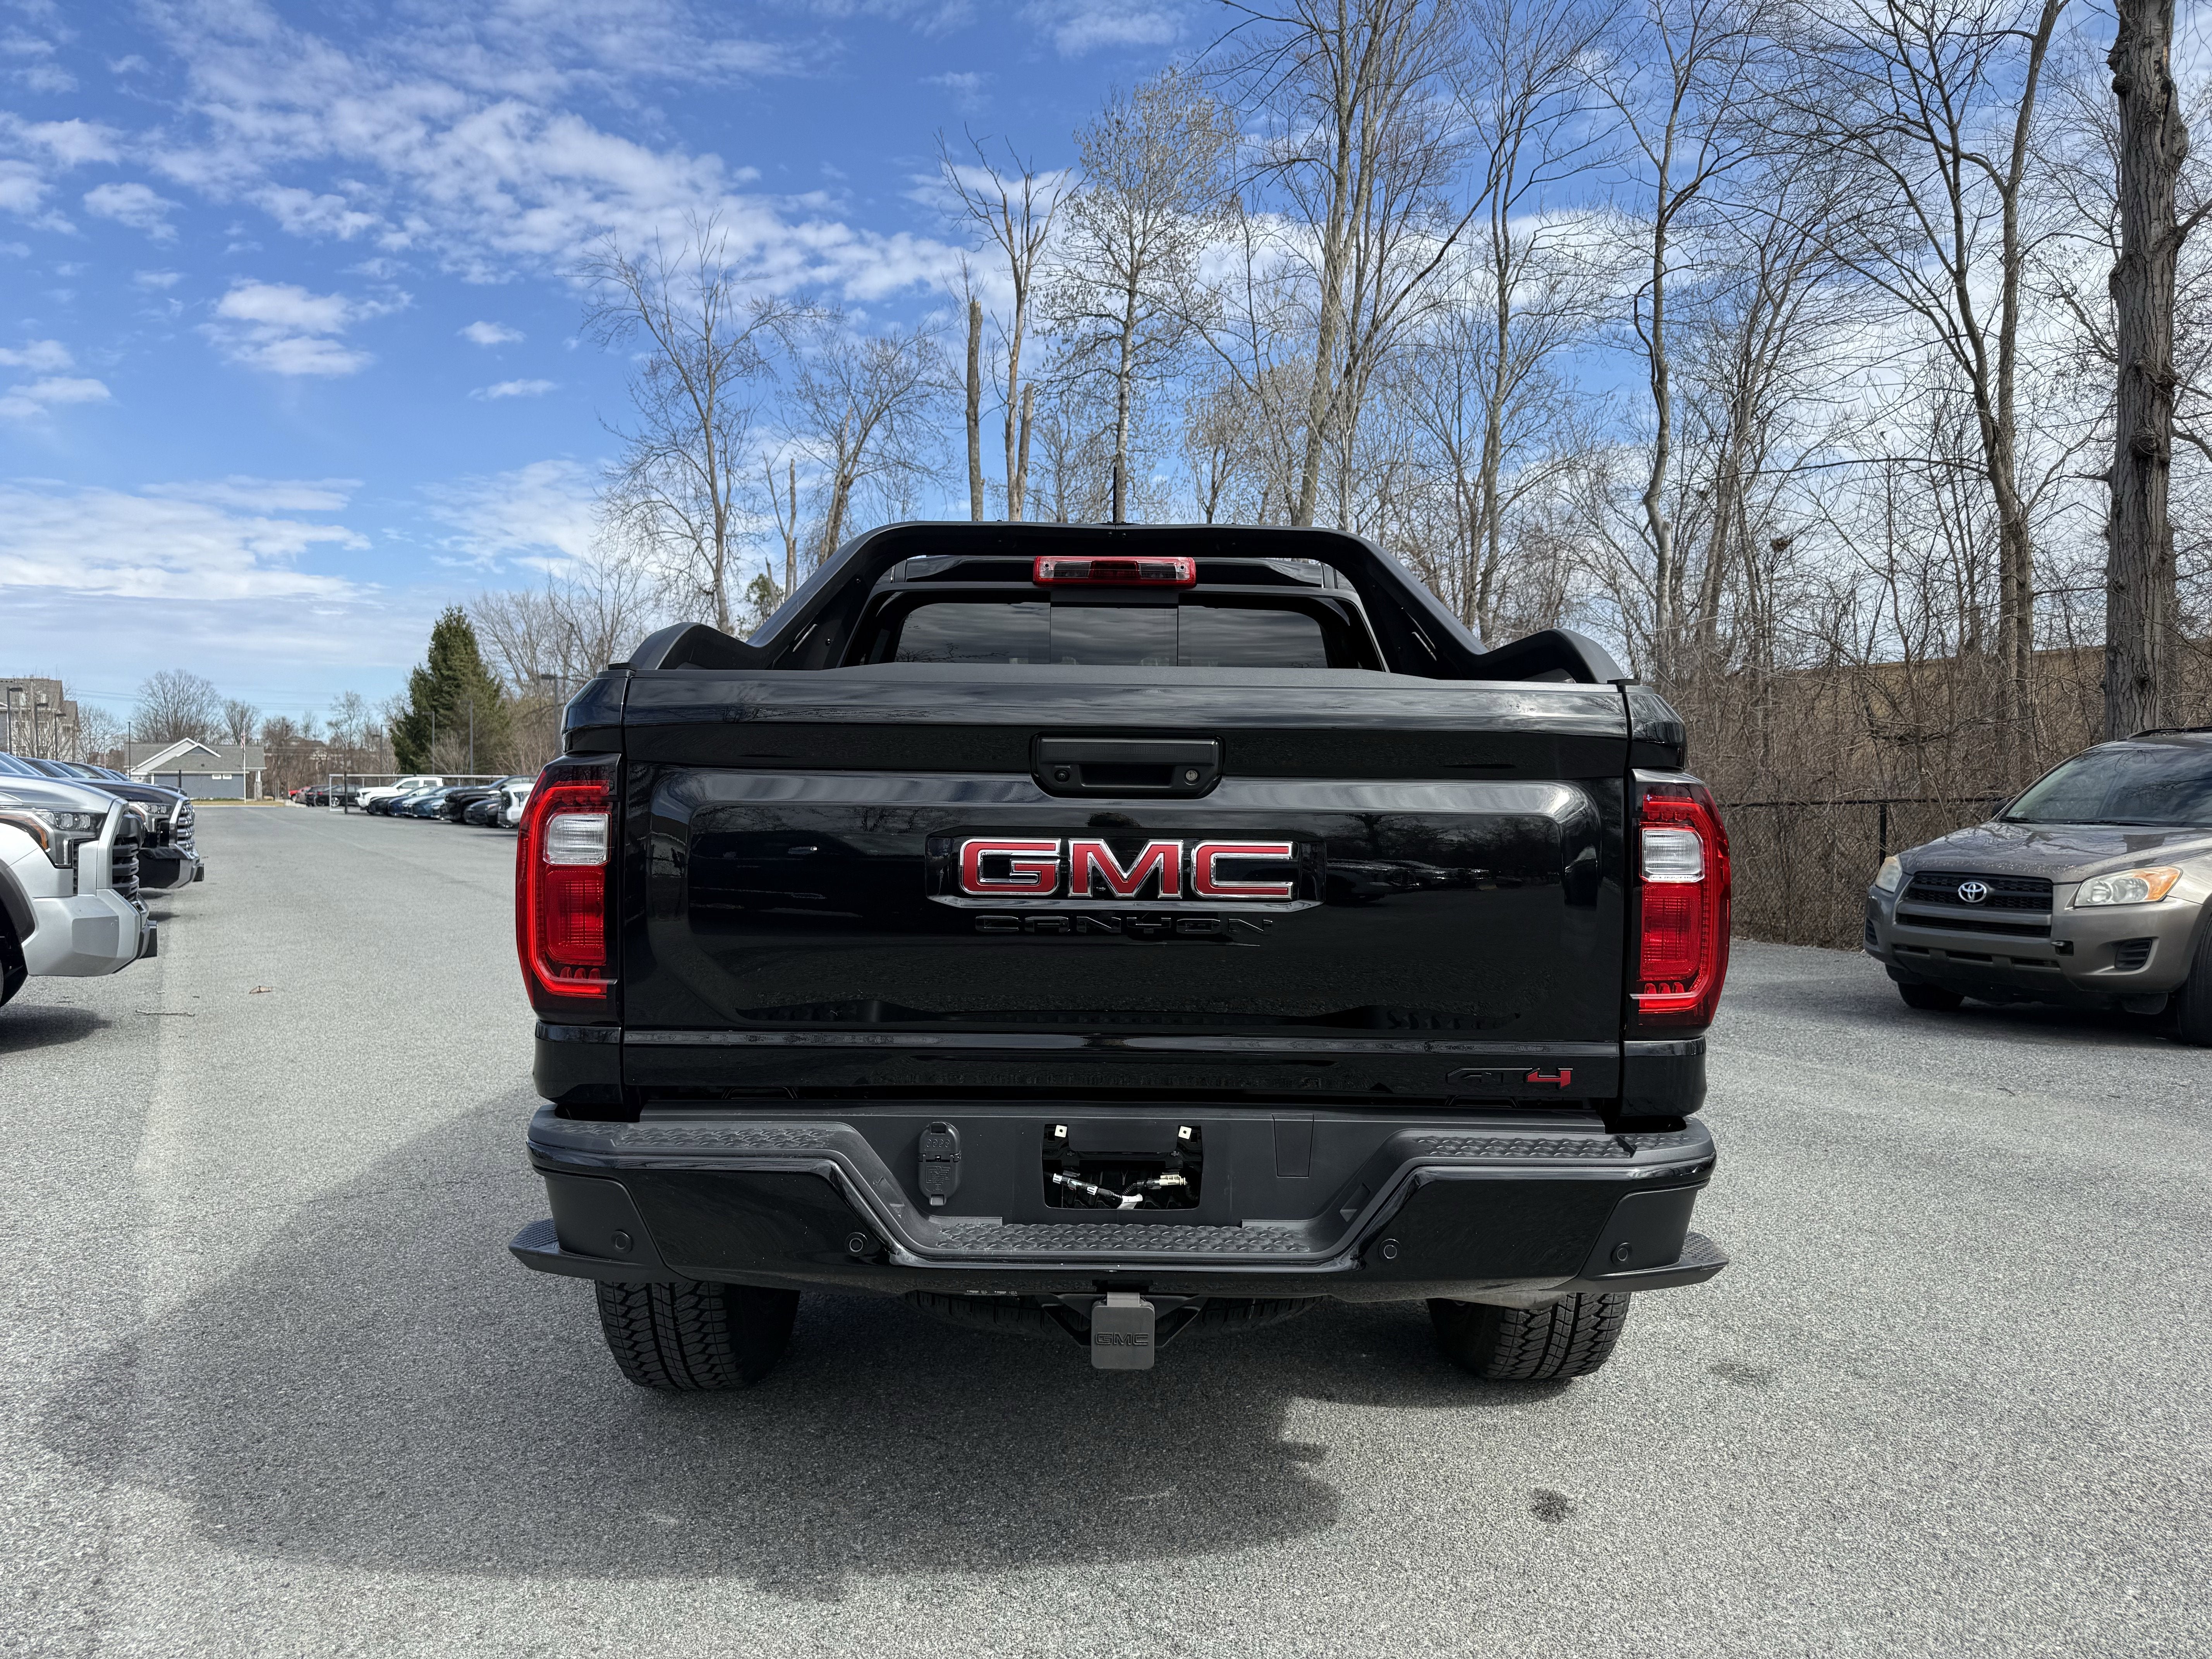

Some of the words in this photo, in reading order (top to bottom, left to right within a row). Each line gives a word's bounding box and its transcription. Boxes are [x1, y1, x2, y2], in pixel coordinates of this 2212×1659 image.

[959, 838, 1293, 898] GMC
[975, 915, 1273, 935] CANYON
[1096, 1332, 1149, 1346] GMC
